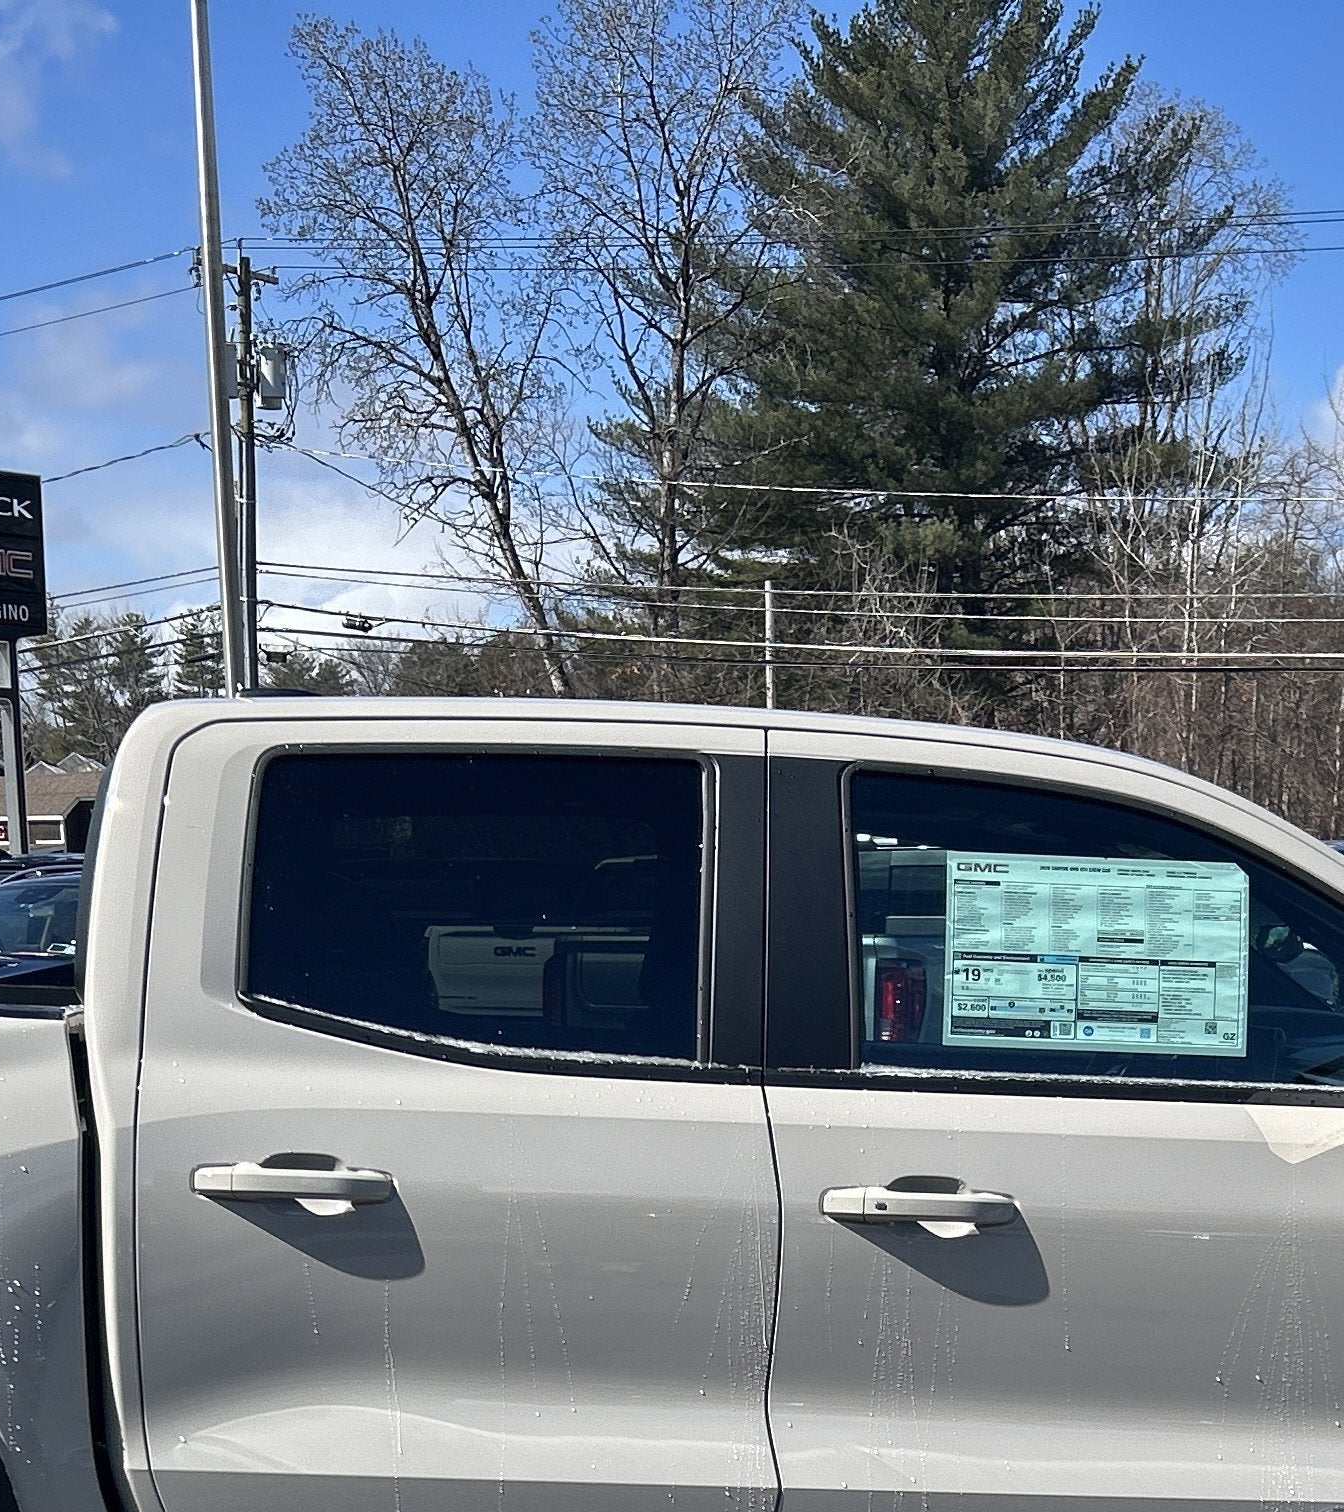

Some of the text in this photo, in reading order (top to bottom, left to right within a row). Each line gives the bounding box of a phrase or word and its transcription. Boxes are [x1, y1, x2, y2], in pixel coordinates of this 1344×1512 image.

[957, 862, 1009, 874] GMC
[494, 946, 537, 957] GMC
[962, 967, 981, 981] 19
[1037, 973, 1067, 983] $4,500
